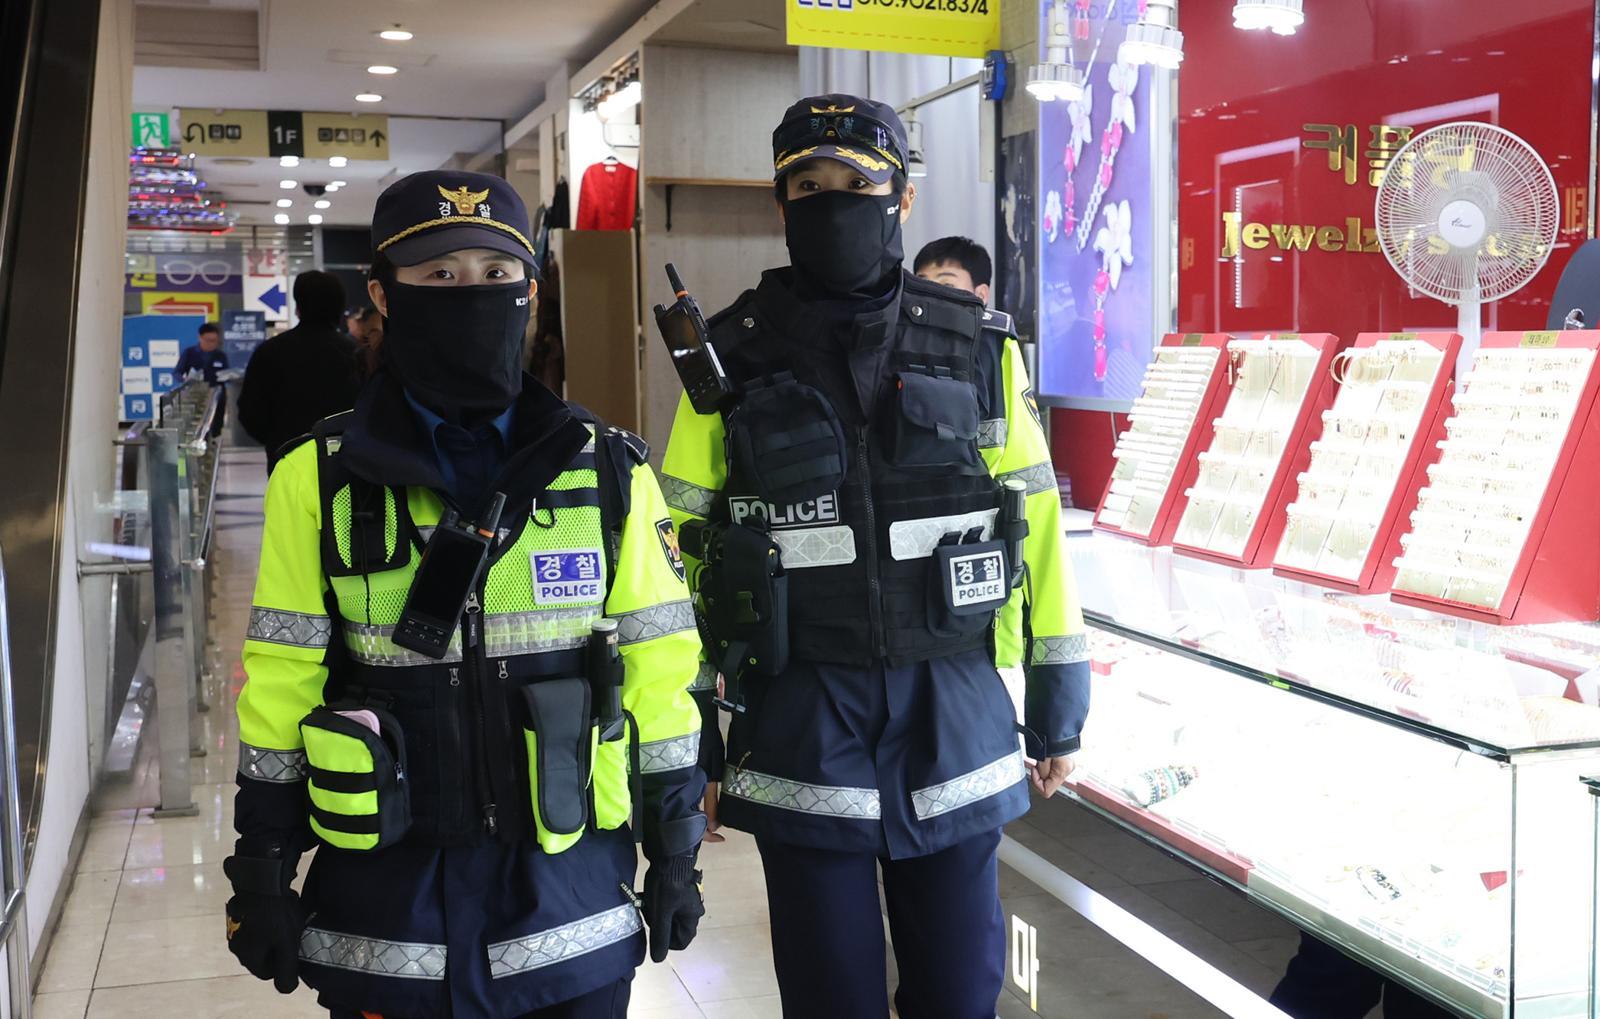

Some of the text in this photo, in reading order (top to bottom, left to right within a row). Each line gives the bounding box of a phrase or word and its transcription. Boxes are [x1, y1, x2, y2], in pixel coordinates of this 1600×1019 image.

[857, 0, 989, 15] .021.8374
[273, 125, 297, 145] 1F
[733, 494, 836, 525] POLICE
[541, 584, 598, 598] POLICE
[959, 584, 999, 600] POLICE
